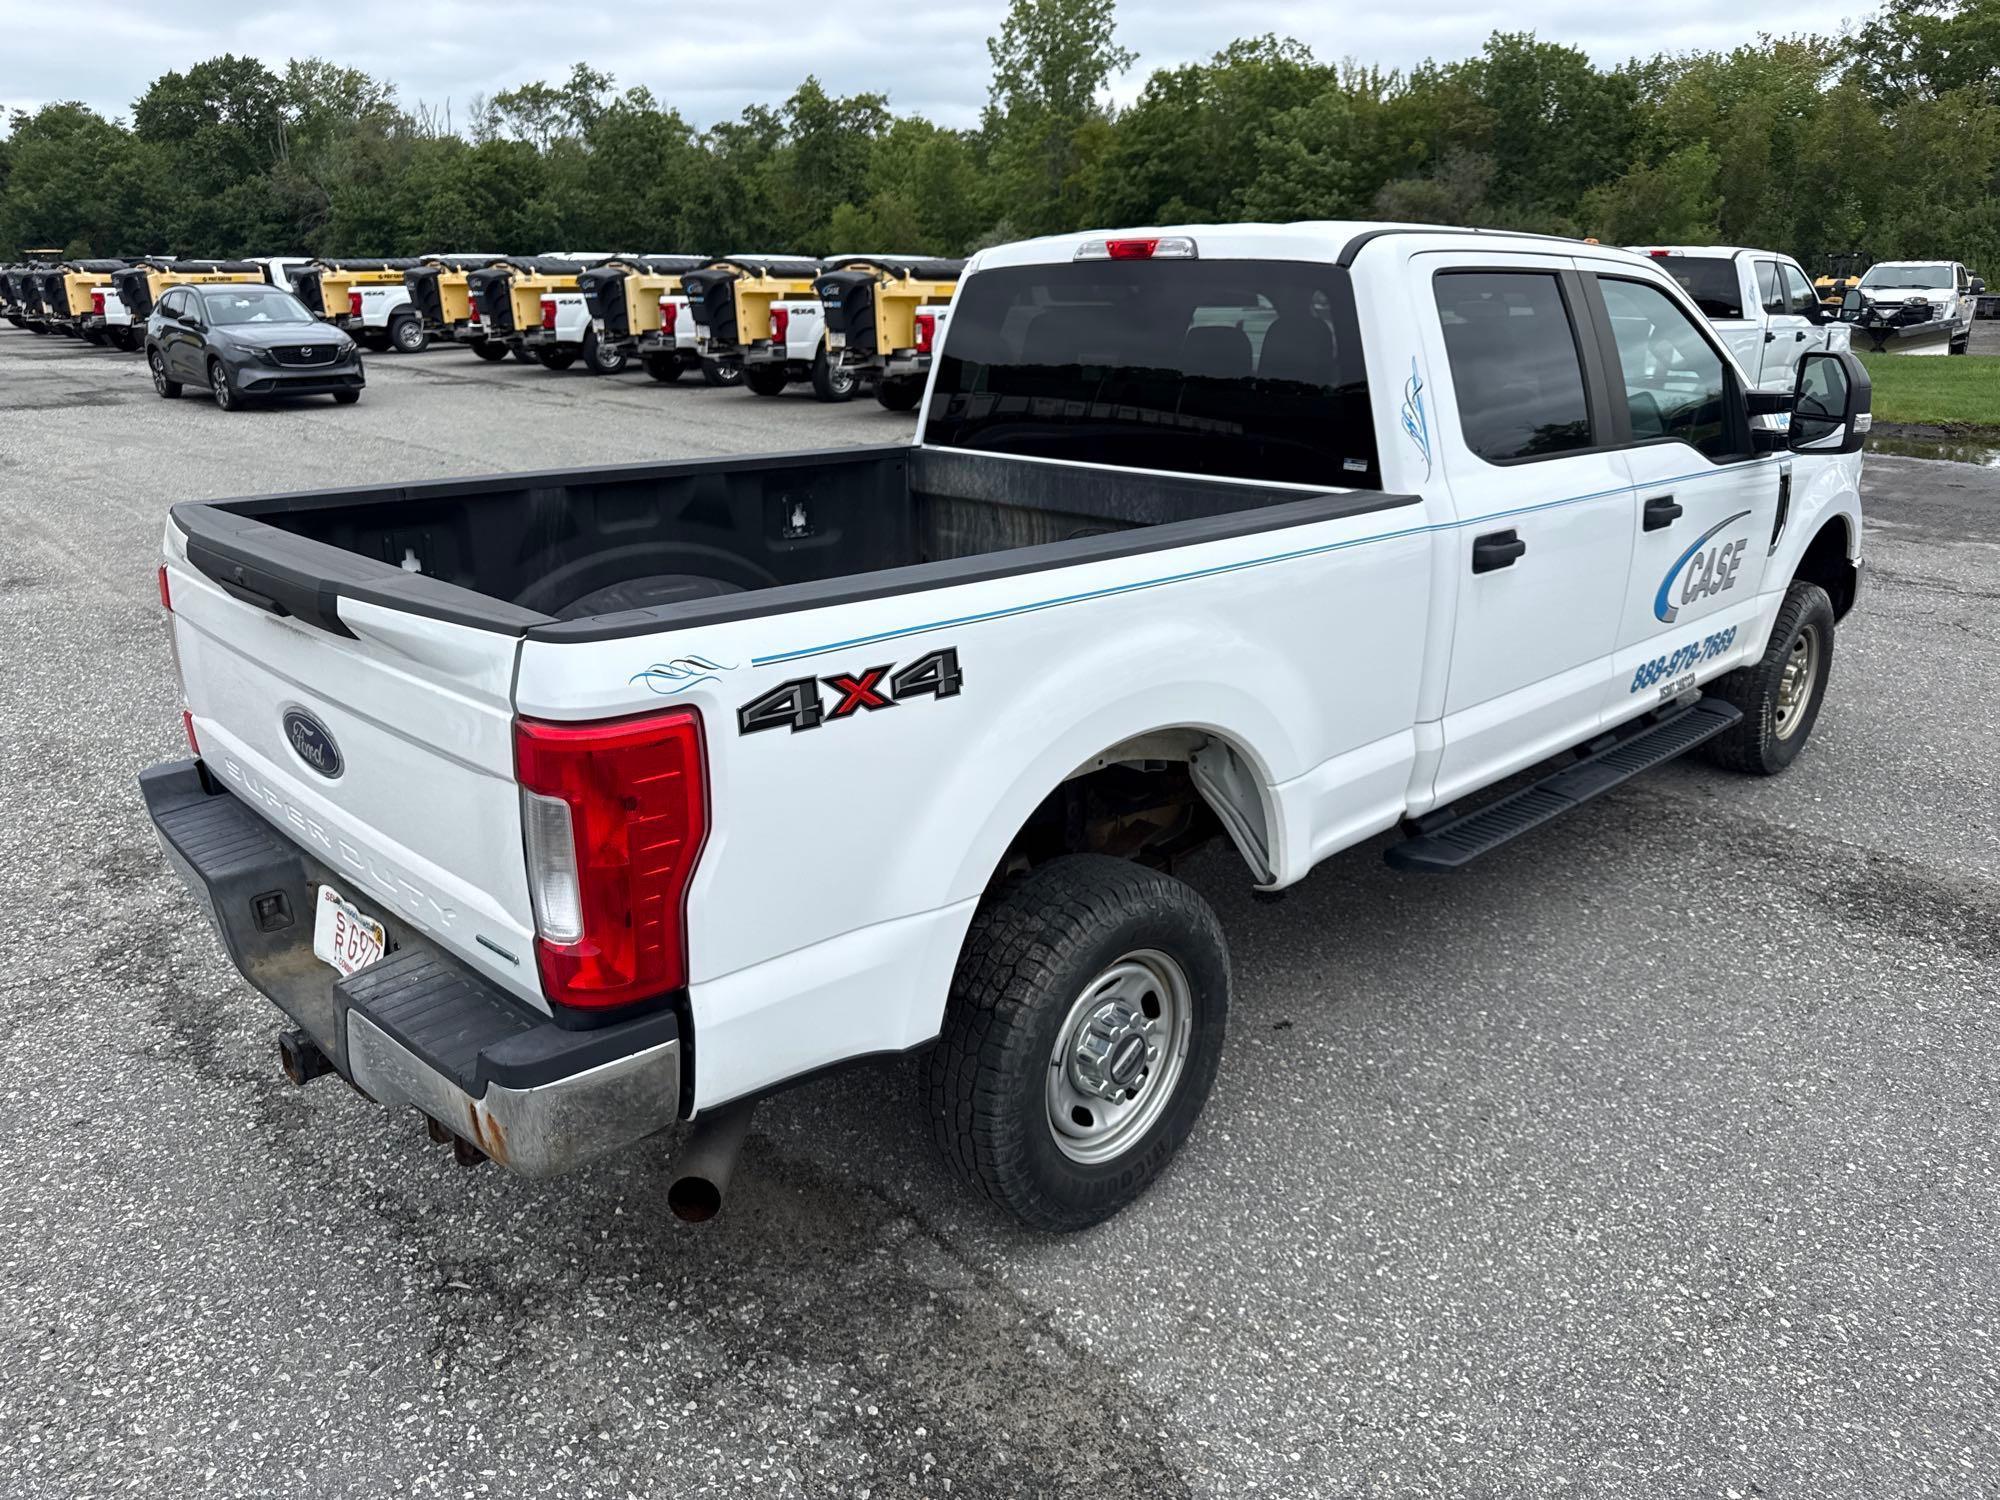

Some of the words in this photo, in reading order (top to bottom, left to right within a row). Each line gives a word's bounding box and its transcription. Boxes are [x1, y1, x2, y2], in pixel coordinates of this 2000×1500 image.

[1681, 538, 1748, 605] CASE
[1630, 625, 1737, 693] 888-978-7669
[291, 720, 325, 767] Ford
[224, 757, 331, 848] SUPER
[338, 839, 457, 928] DUTY
